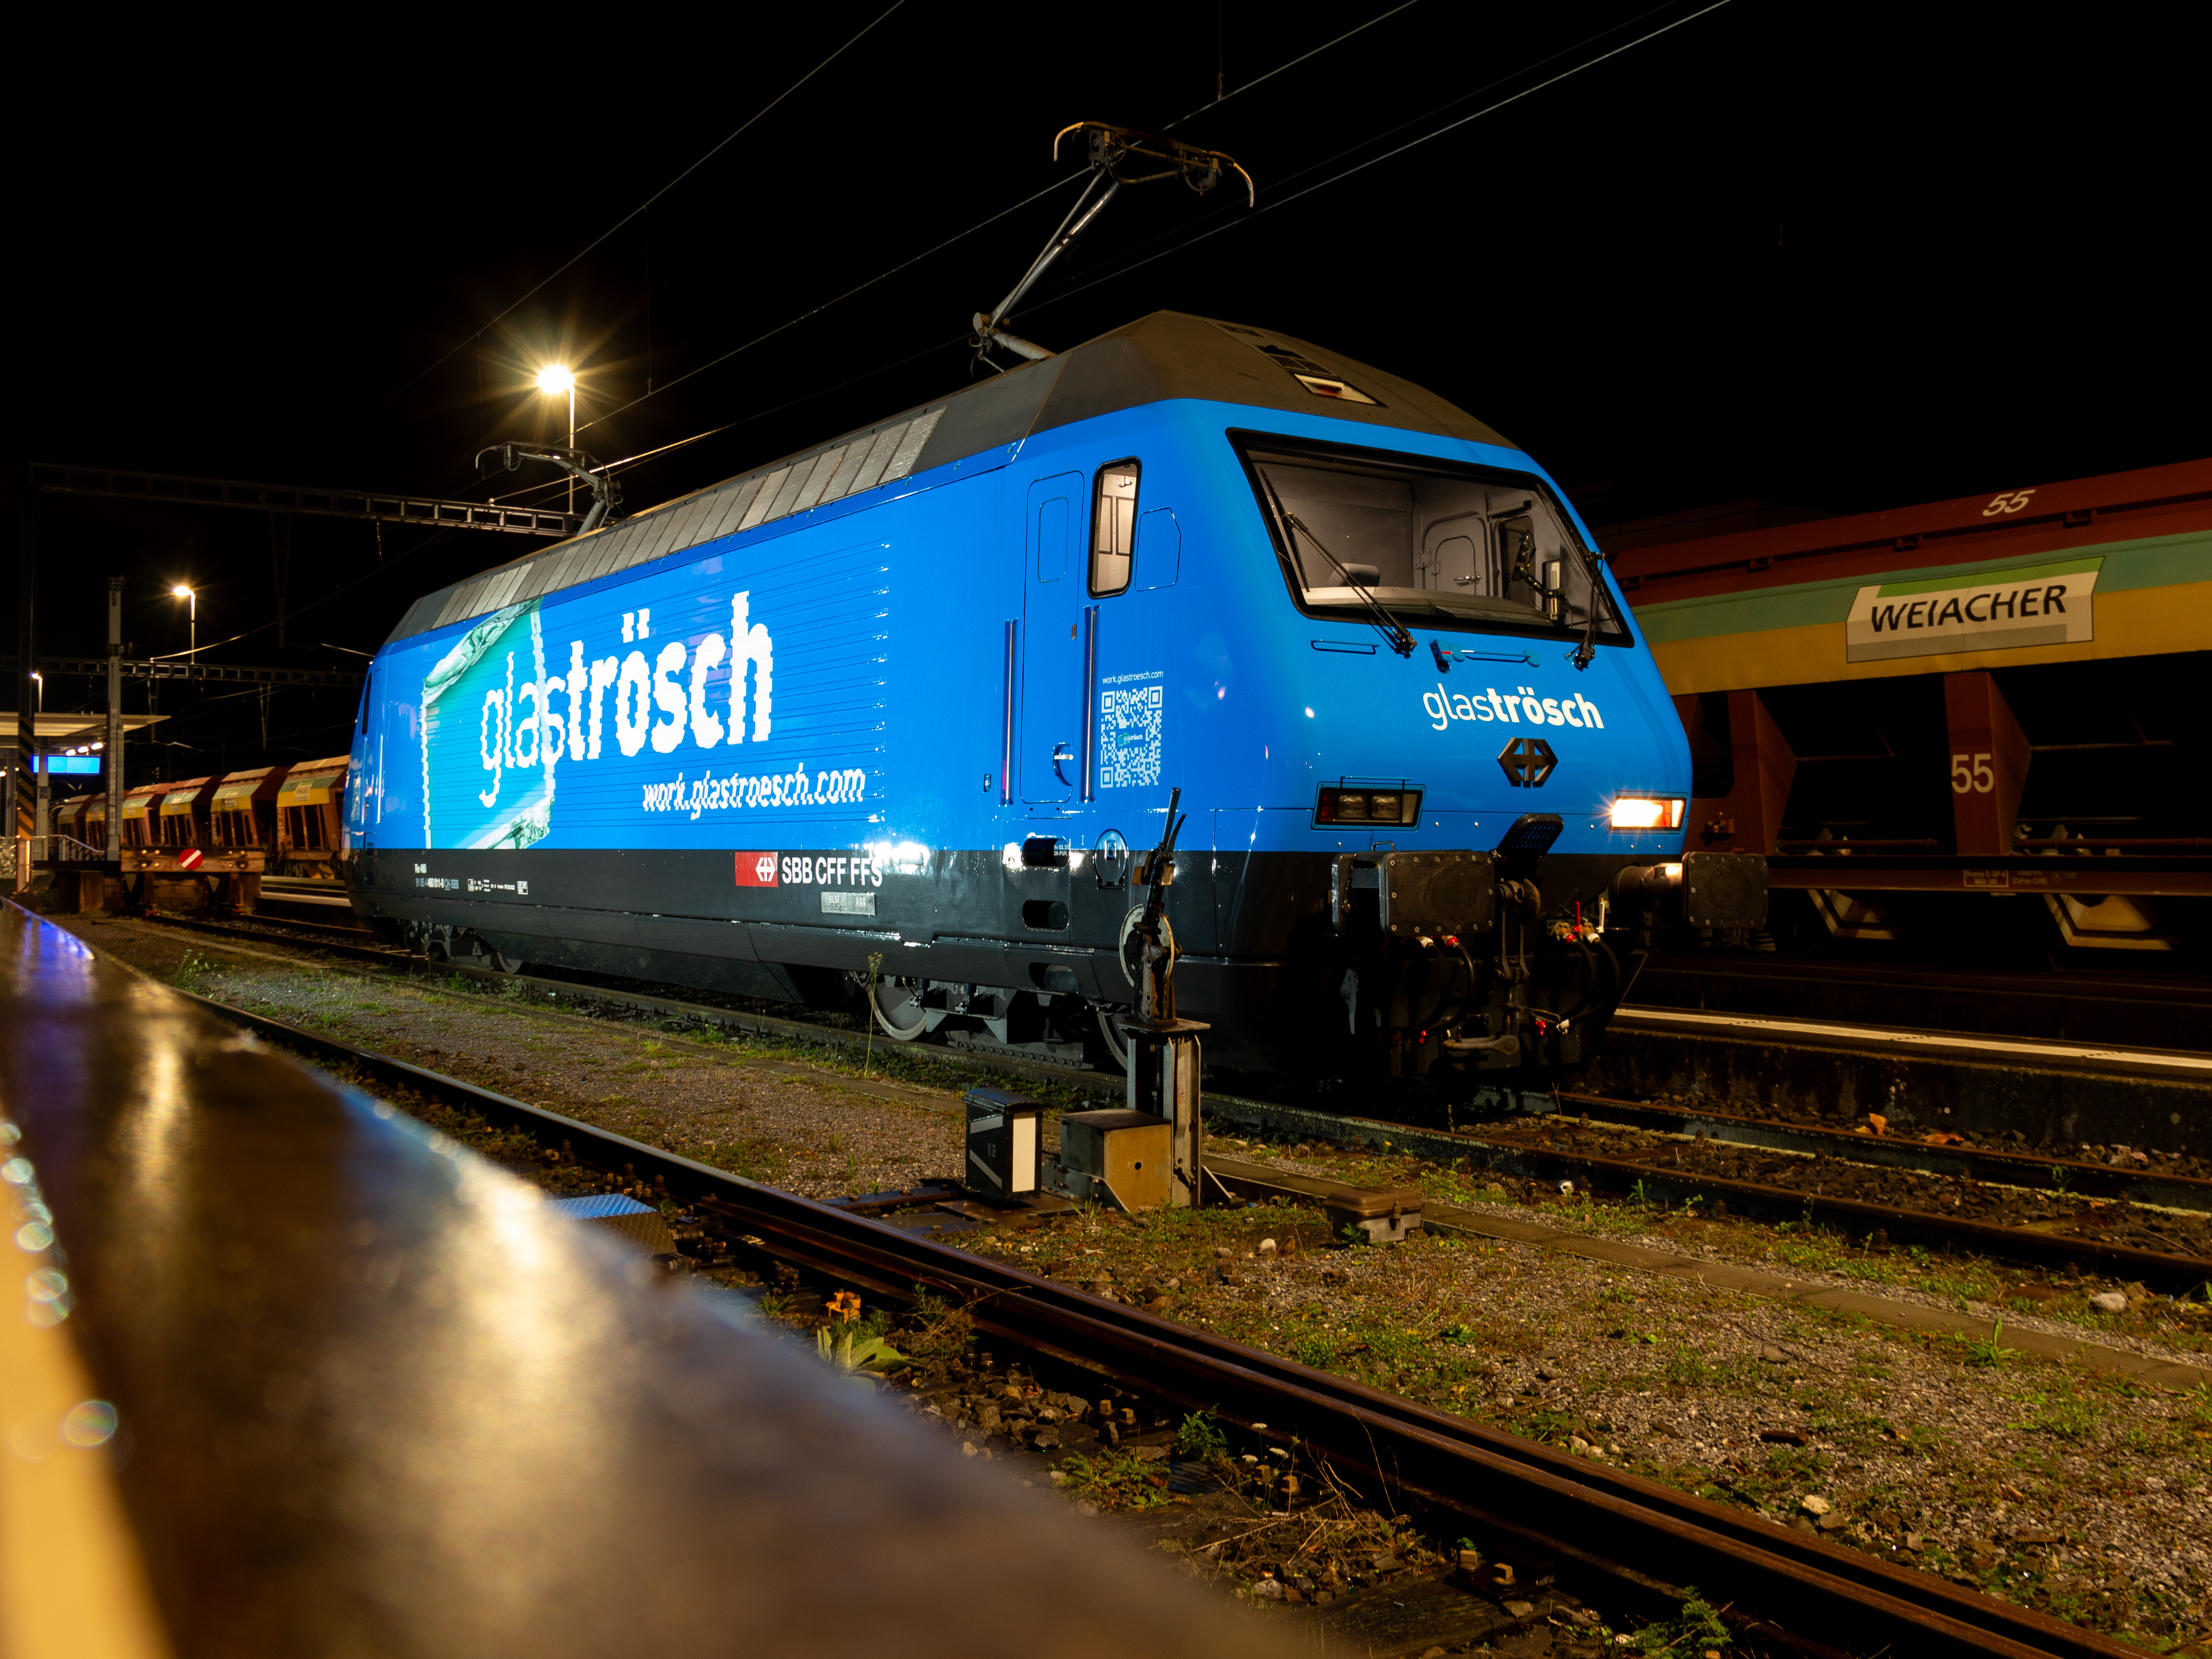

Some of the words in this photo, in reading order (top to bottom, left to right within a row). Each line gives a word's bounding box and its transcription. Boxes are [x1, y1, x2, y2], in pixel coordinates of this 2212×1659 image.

[1982, 489, 2036, 517] 55
[1871, 584, 2067, 633] WEIACHER
[1102, 670, 1163, 684] work.glastroesch.com
[479, 590, 774, 808] glaströsch
[1423, 683, 1604, 730] glaströsch
[643, 763, 866, 820] work.glastroesch.com
[1951, 753, 1994, 794] 55
[782, 857, 813, 884] SBB
[815, 857, 846, 885] CFF
[851, 857, 883, 887] FFS
[987, 1142, 996, 1158] 13
